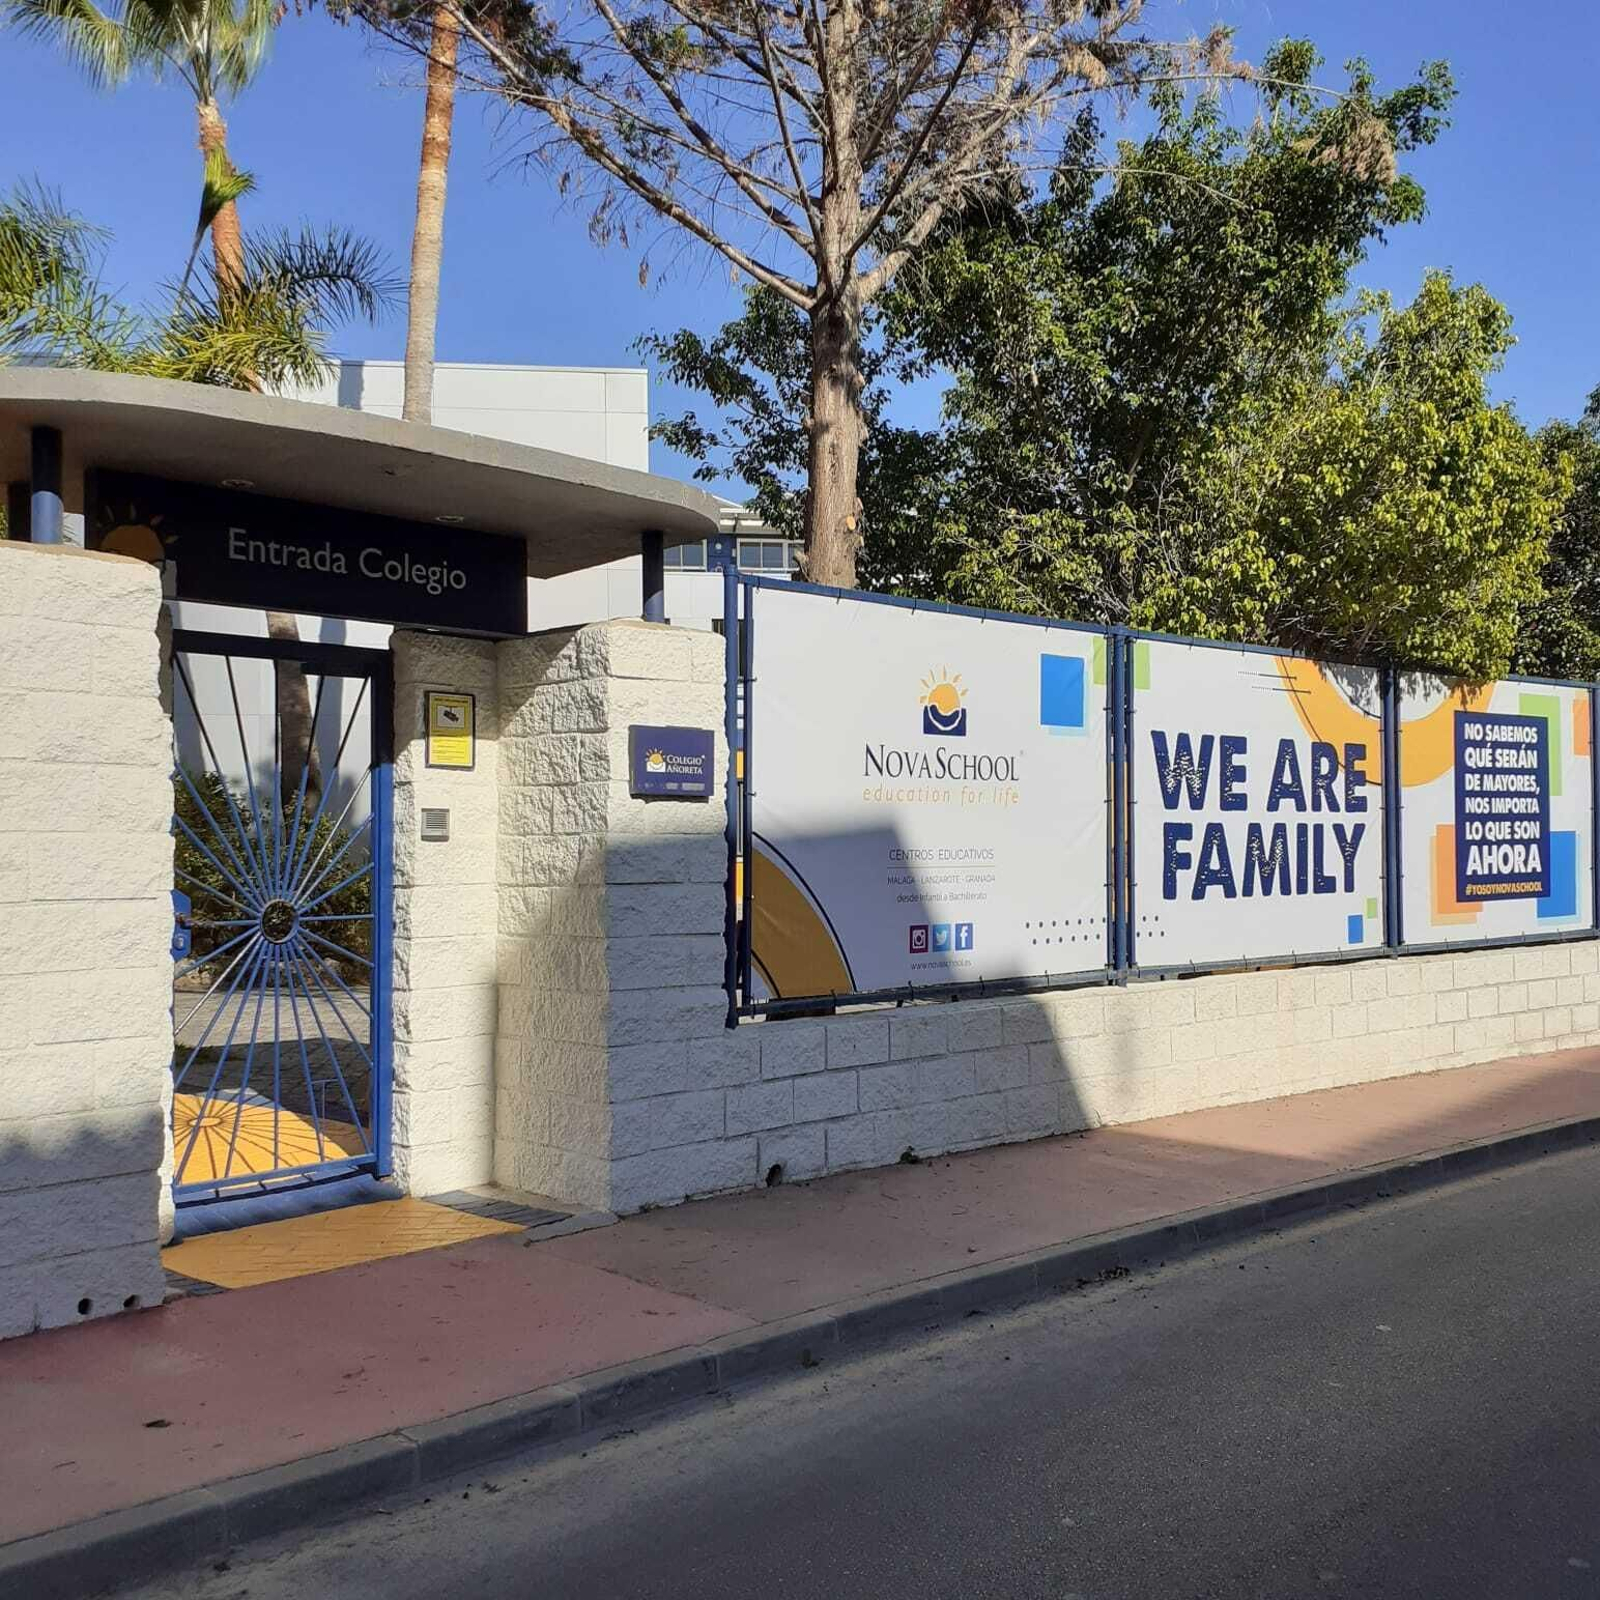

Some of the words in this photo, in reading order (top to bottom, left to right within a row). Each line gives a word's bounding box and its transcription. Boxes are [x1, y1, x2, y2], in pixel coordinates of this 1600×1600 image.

[228, 527, 348, 574] Entrada
[359, 547, 467, 595] Colegio
[1464, 723, 1483, 741] NO
[1485, 724, 1538, 743] SABEMOS
[666, 754, 702, 765] COLEGIO
[1464, 742, 1493, 768] QUÉ
[1494, 743, 1538, 769] SERÁN
[666, 763, 703, 775] AÑORETA
[1150, 729, 1248, 811] WE
[1266, 738, 1368, 812] ARE
[1464, 773, 1481, 792] DE
[1483, 774, 1540, 795] MAYORES,
[863, 784, 950, 804] education
[961, 786, 983, 807] for
[994, 786, 1019, 808] life
[1465, 797, 1490, 814] NOS
[1492, 798, 1539, 814] IMPORTA
[1465, 821, 1483, 840] LO
[1485, 821, 1511, 841] QUE
[1514, 821, 1540, 839] SON
[889, 849, 934, 861] CENTROS
[939, 848, 995, 860] EDUCATIVOS
[1163, 822, 1365, 900] FAMILY
[1466, 844, 1542, 875] AHORA
[897, 893, 919, 903] desde
[1465, 882, 1543, 896] #YOSOYNOVASCHOOL
